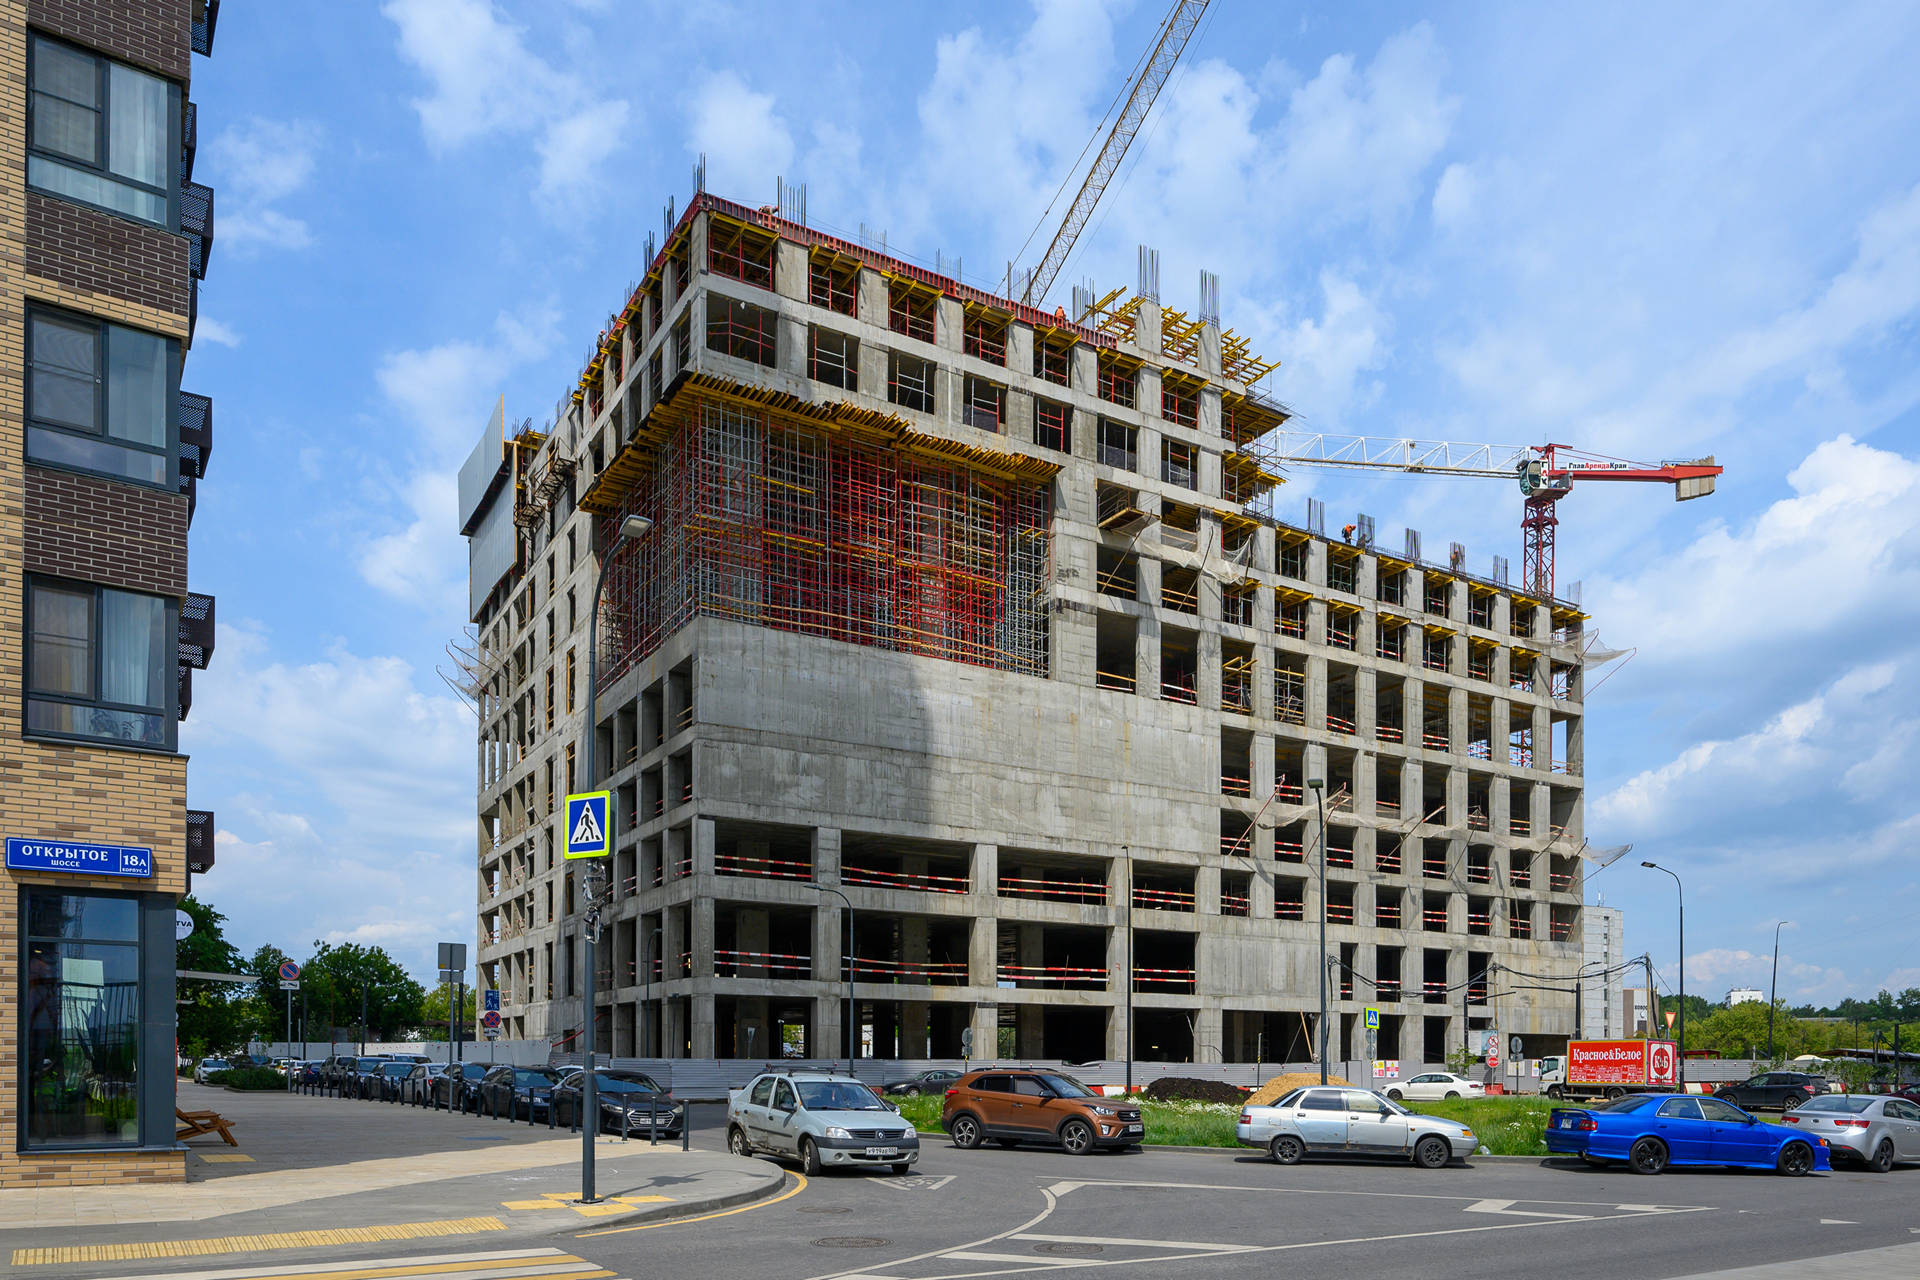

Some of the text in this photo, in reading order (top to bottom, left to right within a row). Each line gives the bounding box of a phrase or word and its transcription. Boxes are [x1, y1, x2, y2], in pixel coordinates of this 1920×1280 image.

[1568, 462, 1627, 470] ГлавАрендаКран
[22, 845, 109, 861] ОТКРЫТОЕ
[51, 859, 81, 867] ШОССЕ
[1573, 1047, 1642, 1063] Красное&Белое
